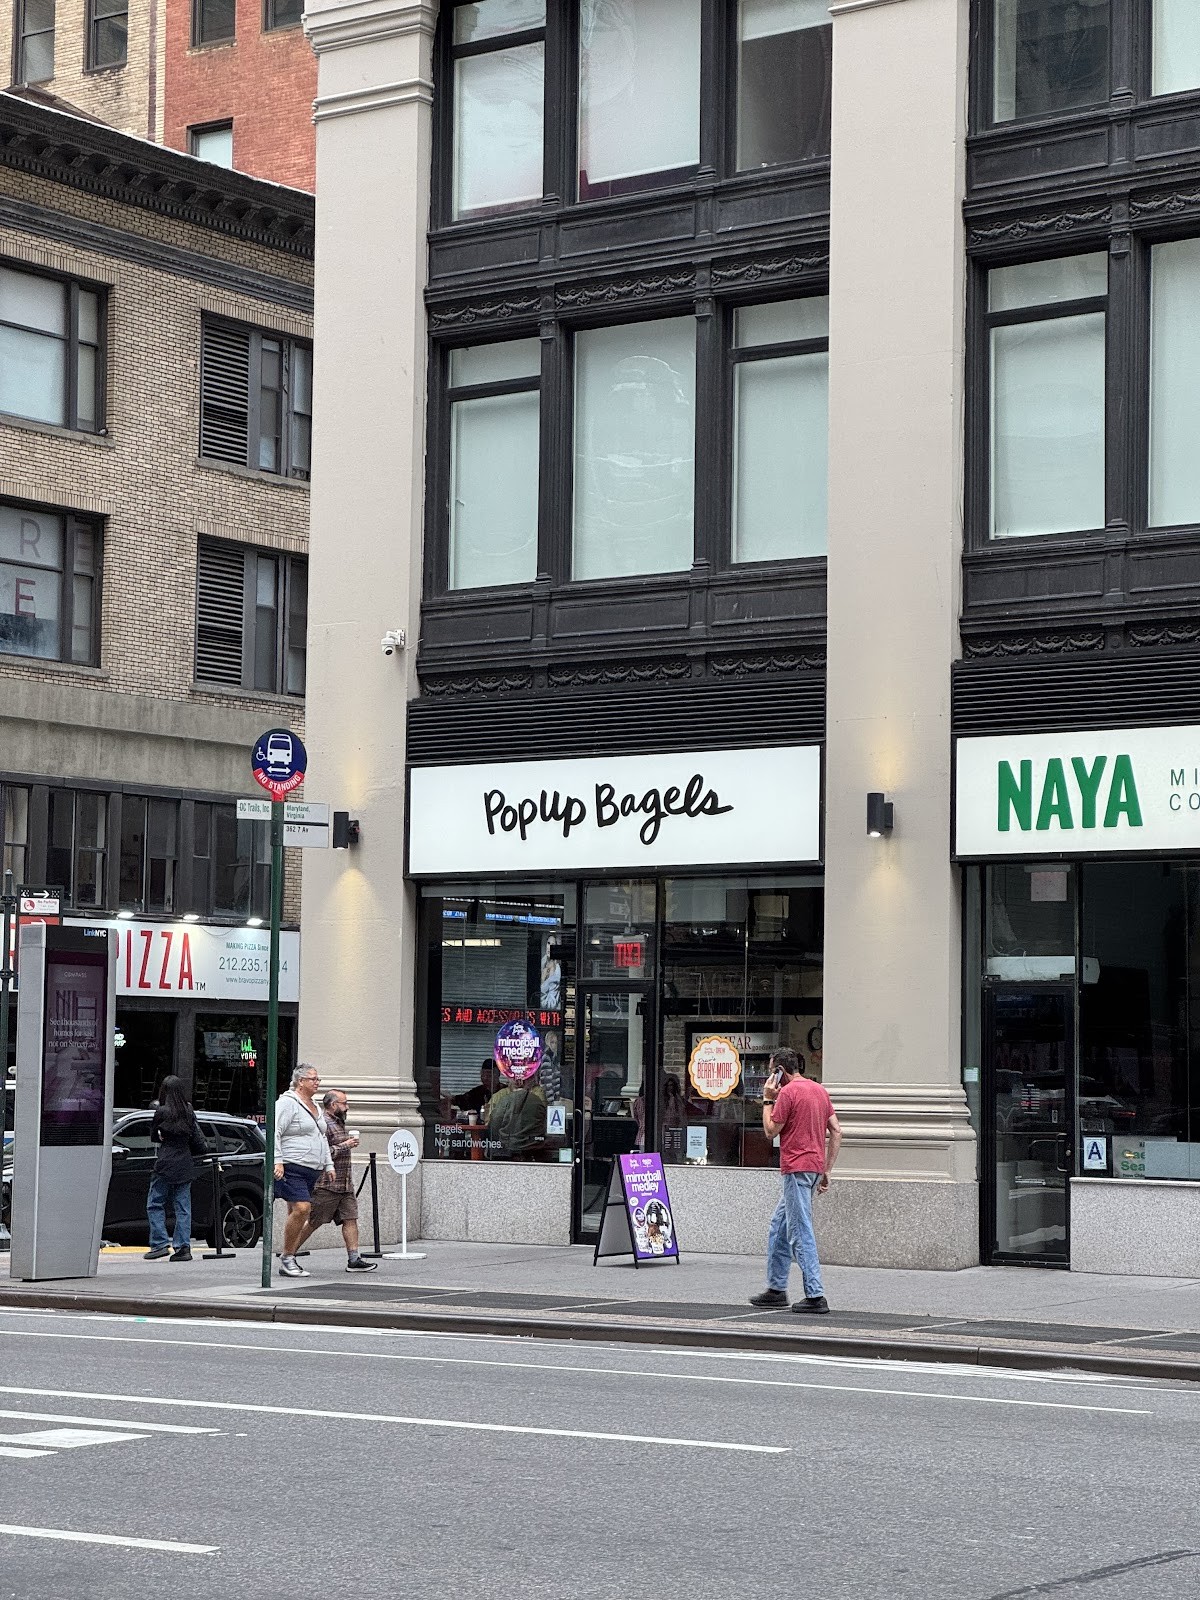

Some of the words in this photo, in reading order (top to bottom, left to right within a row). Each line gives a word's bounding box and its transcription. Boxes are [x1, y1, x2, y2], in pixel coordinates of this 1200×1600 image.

[257, 772, 268, 784] NO
[268, 774, 302, 791] STANDING
[997, 754, 1144, 832] NAYA
[1169, 792, 1200, 811] CO
[262, 804, 270, 813] Inc
[286, 804, 311, 813] Maryland,
[483, 789, 587, 842] PopUp
[595, 774, 735, 846] Bagels
[286, 812, 305, 820] Virginia
[83, 929, 107, 938] LinkNYC
[226, 942, 244, 951] MAKING
[243, 943, 257, 952] PIZZA
[116, 929, 194, 991] IZZA
[195, 982, 206, 991] TM
[218, 955, 289, 974] 212.235.14
[455, 1007, 473, 1024] AND
[61, 1018, 91, 1027] thousands
[53, 1028, 74, 1037] homes
[48, 1040, 59, 1048] not
[59, 1040, 68, 1048] on
[498, 1036, 540, 1048] mirrorball
[241, 1052, 257, 1060] YORK
[502, 1046, 535, 1058] medley
[706, 1079, 724, 1087] BUTTER
[550, 1110, 562, 1126] A
[434, 1124, 464, 1135] Bagels.
[434, 1138, 451, 1148] Not
[451, 1138, 503, 1149] sandwiches.
[393, 1150, 415, 1162] Bagels
[1088, 1141, 1102, 1160] A
[626, 1170, 662, 1183] mirrorball
[631, 1181, 660, 1194] medley
